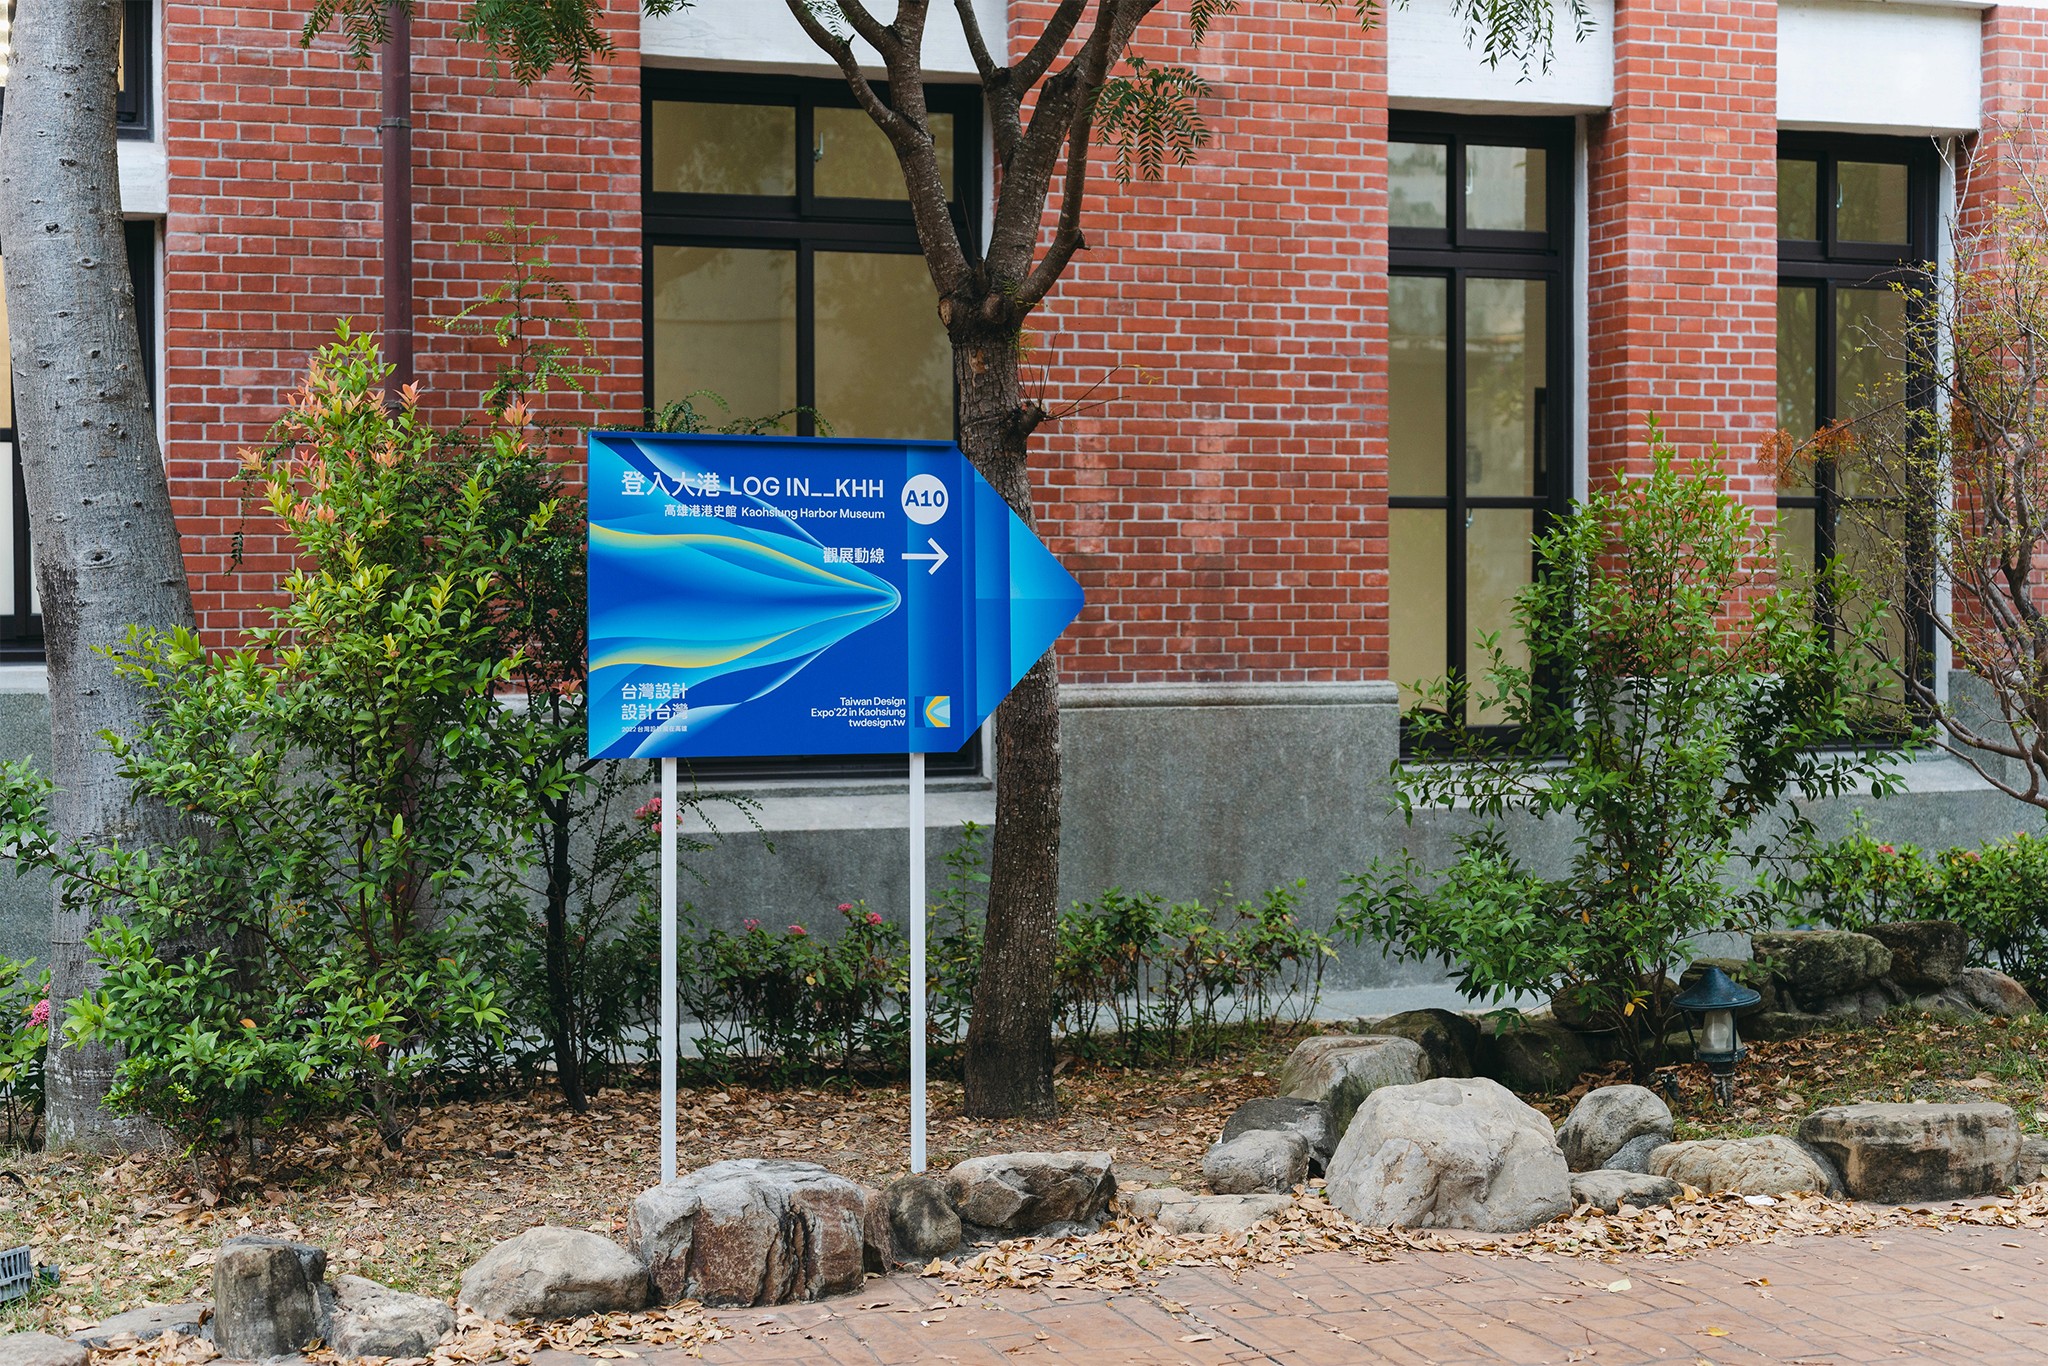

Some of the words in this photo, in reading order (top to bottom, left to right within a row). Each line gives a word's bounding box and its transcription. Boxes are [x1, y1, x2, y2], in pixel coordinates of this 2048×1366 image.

[621, 471, 720, 496] 登入大港
[730, 476, 780, 496] LOG
[905, 490, 945, 507] A10
[664, 504, 737, 518] 高雄港港史館
[741, 506, 798, 519] Kaohsiung
[800, 507, 838, 518] Harbor
[840, 508, 885, 519] Museum
[823, 547, 885, 563] 觀展動線
[621, 683, 688, 699] 台灣設計
[840, 697, 872, 705] Taiwan
[874, 697, 906, 707] Design
[621, 704, 688, 720] 設計台灣
[849, 708, 857, 716] in
[858, 708, 906, 717] Kaohsiung
[849, 718, 906, 729] twdesign.tw
